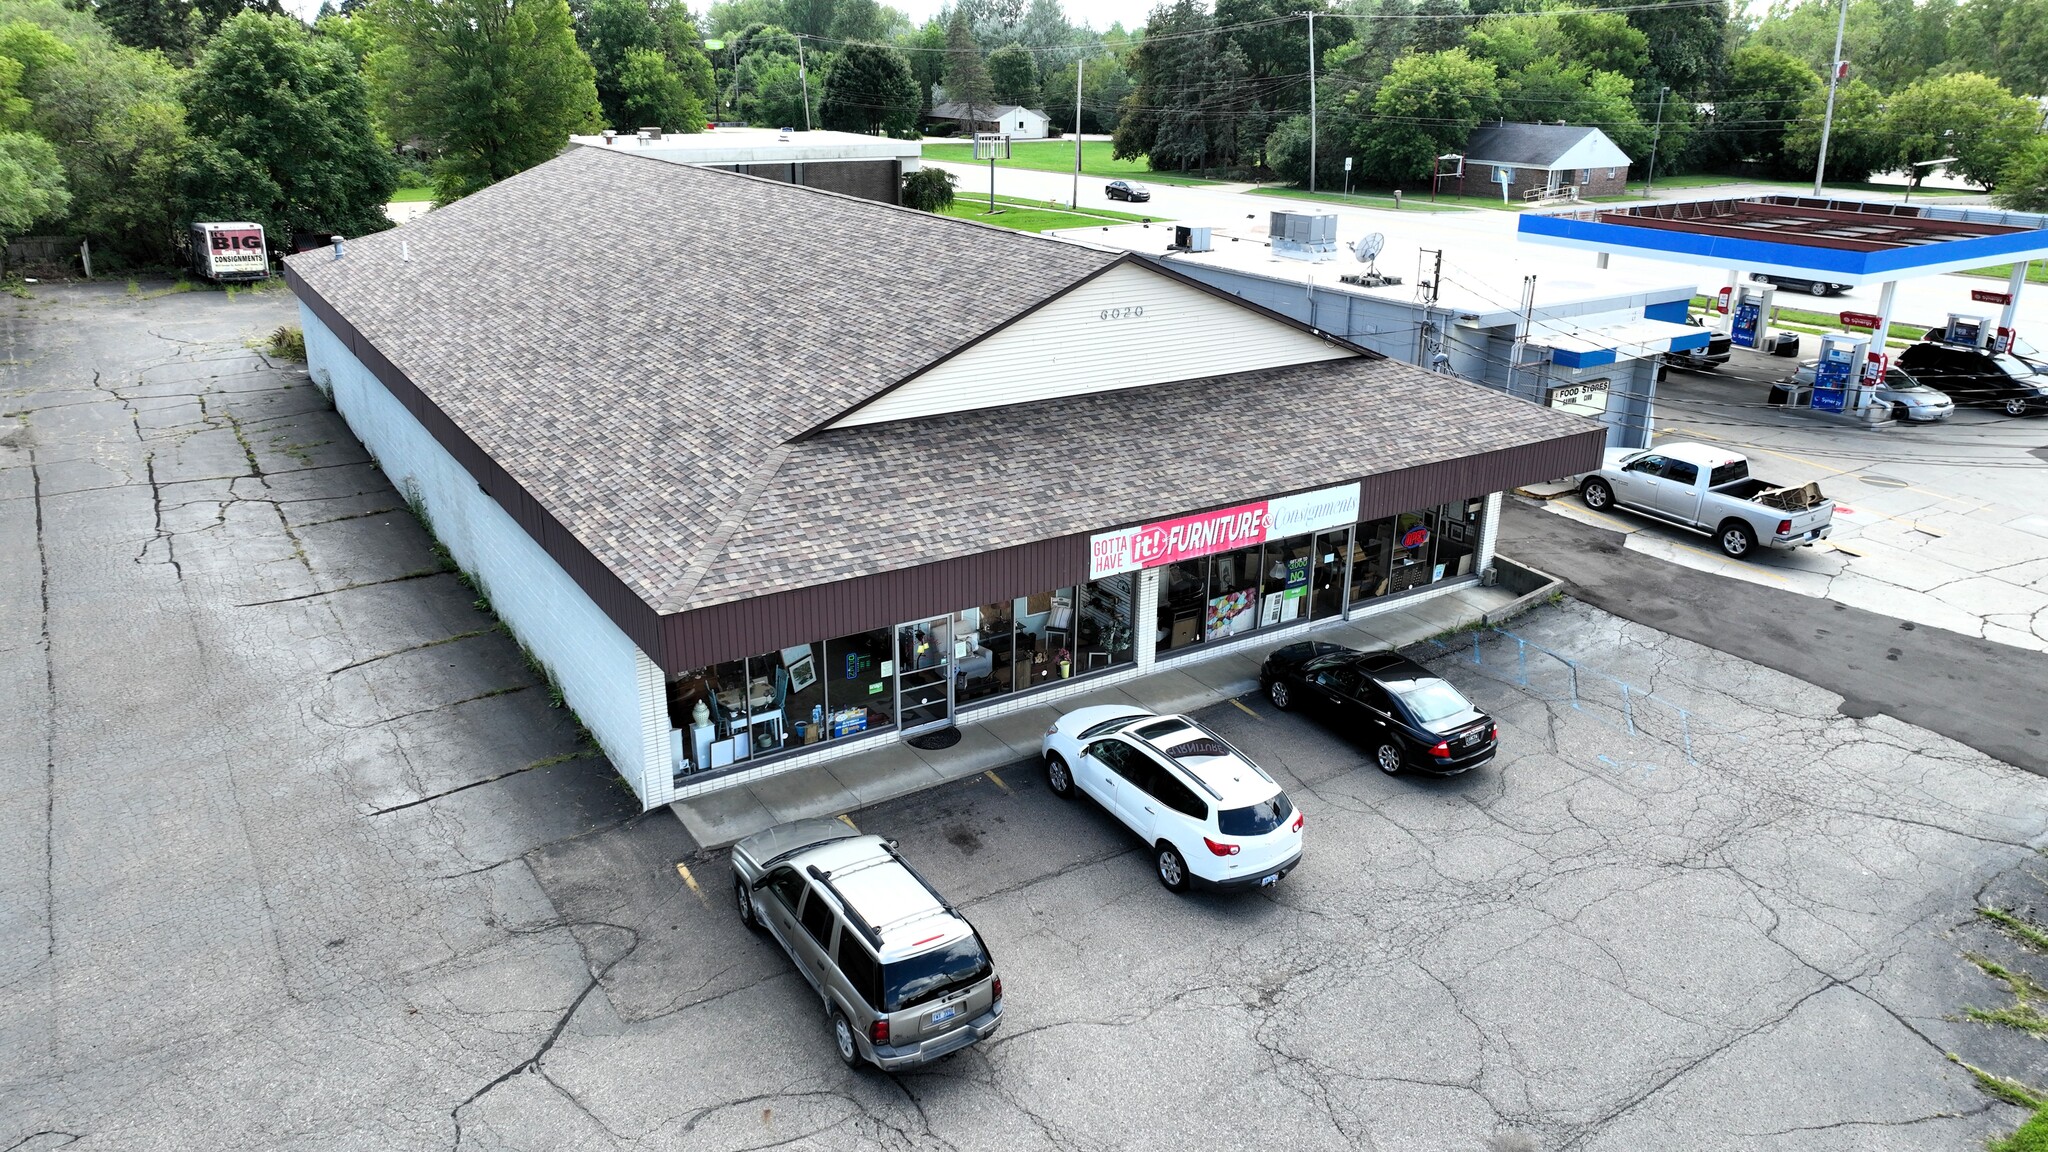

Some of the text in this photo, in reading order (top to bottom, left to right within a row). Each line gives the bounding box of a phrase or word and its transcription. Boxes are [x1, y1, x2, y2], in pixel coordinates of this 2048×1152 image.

[212, 236, 261, 249] BIG
[215, 255, 262, 263] CONSIGNMENTS
[1100, 306, 1143, 320] 6020
[1560, 388, 1579, 397] FOOD
[1582, 382, 1607, 393] STORES
[1821, 397, 1841, 406] Synergy
[1168, 496, 1358, 555] FURNITURE & Consignments
[1094, 536, 1127, 557] GOTTA
[1134, 531, 1160, 560] it!
[1096, 552, 1123, 572] HAVE
[1290, 570, 1304, 581] NO
